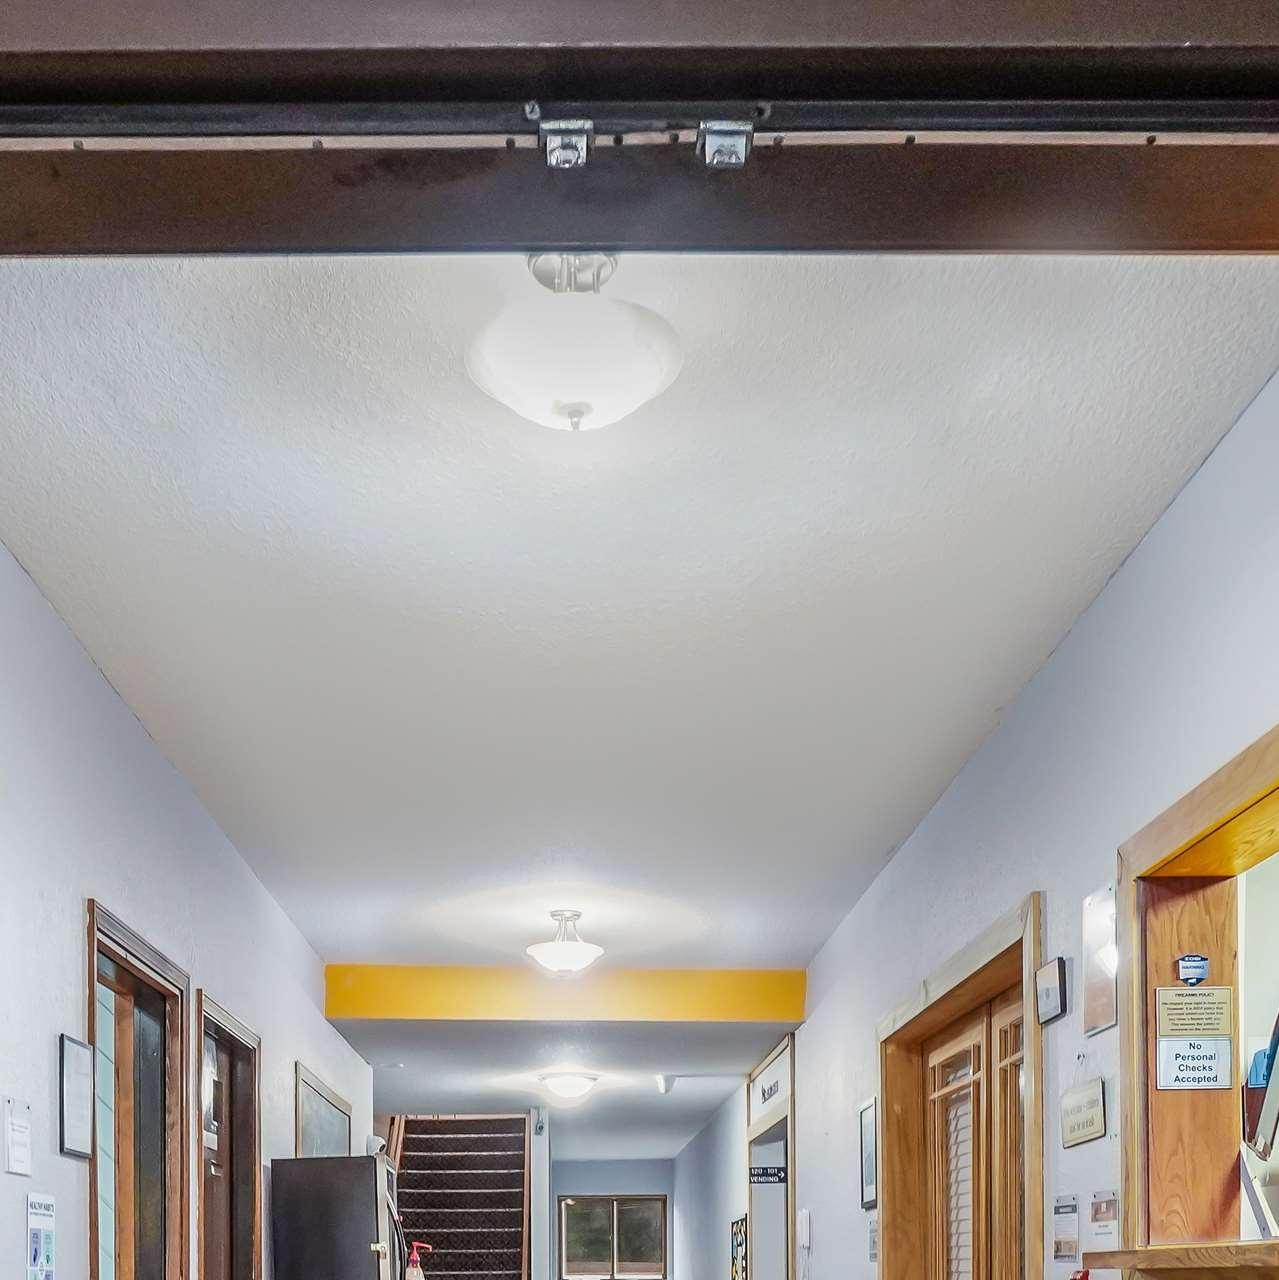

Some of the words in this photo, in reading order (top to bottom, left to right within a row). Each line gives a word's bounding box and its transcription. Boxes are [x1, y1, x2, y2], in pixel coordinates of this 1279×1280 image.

[1189, 1042, 1202, 1050] No
[1175, 1053, 1216, 1061] Personal
[1178, 1063, 1213, 1072] Checks
[1174, 1074, 1218, 1084] Accepted
